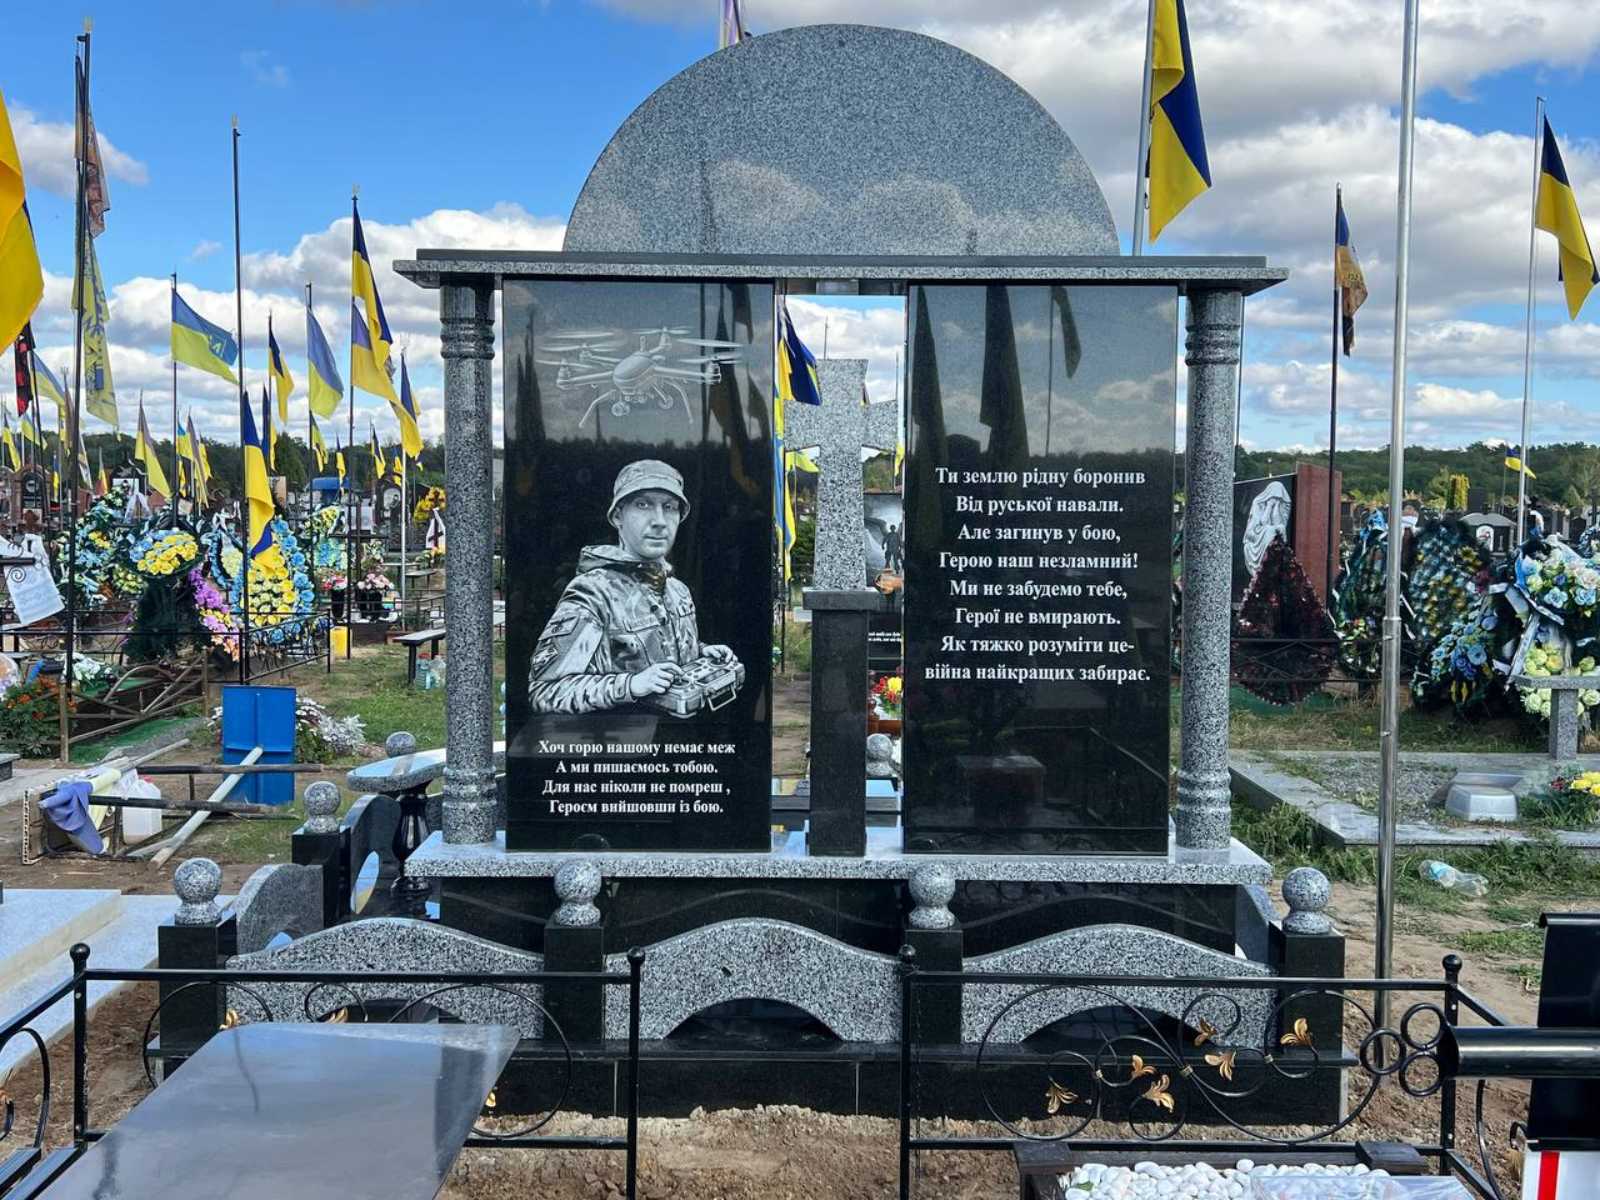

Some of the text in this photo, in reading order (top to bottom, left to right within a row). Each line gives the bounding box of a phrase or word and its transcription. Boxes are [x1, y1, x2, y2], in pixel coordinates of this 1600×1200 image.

[935, 467, 1146, 489] Ти землю рідну боронив
[956, 495, 1124, 516] Від руської навали.
[957, 524, 1121, 545] Але загинув у бою,
[939, 551, 1139, 572] Герою наш незламний!
[950, 579, 1128, 601] Ми не забудемо тебе,
[955, 607, 1121, 629] Герої не вмирають.
[940, 635, 966, 652] Як
[969, 639, 1024, 652] тяжко
[1028, 636, 1104, 657] розуміти
[925, 663, 1151, 685] війна найкращих забирає.
[538, 739, 736, 757] Хоч горю нашому немає меж
[555, 760, 567, 774] А
[570, 763, 590, 774] ми
[673, 760, 719, 774] тобою.
[541, 779, 570, 795] Для
[574, 783, 598, 793] нас
[600, 779, 646, 793] ніколи
[650, 783, 666, 793] не
[601, 799, 676, 813] вийшовши
[679, 799, 690, 813] із
[693, 799, 724, 813] бою.
